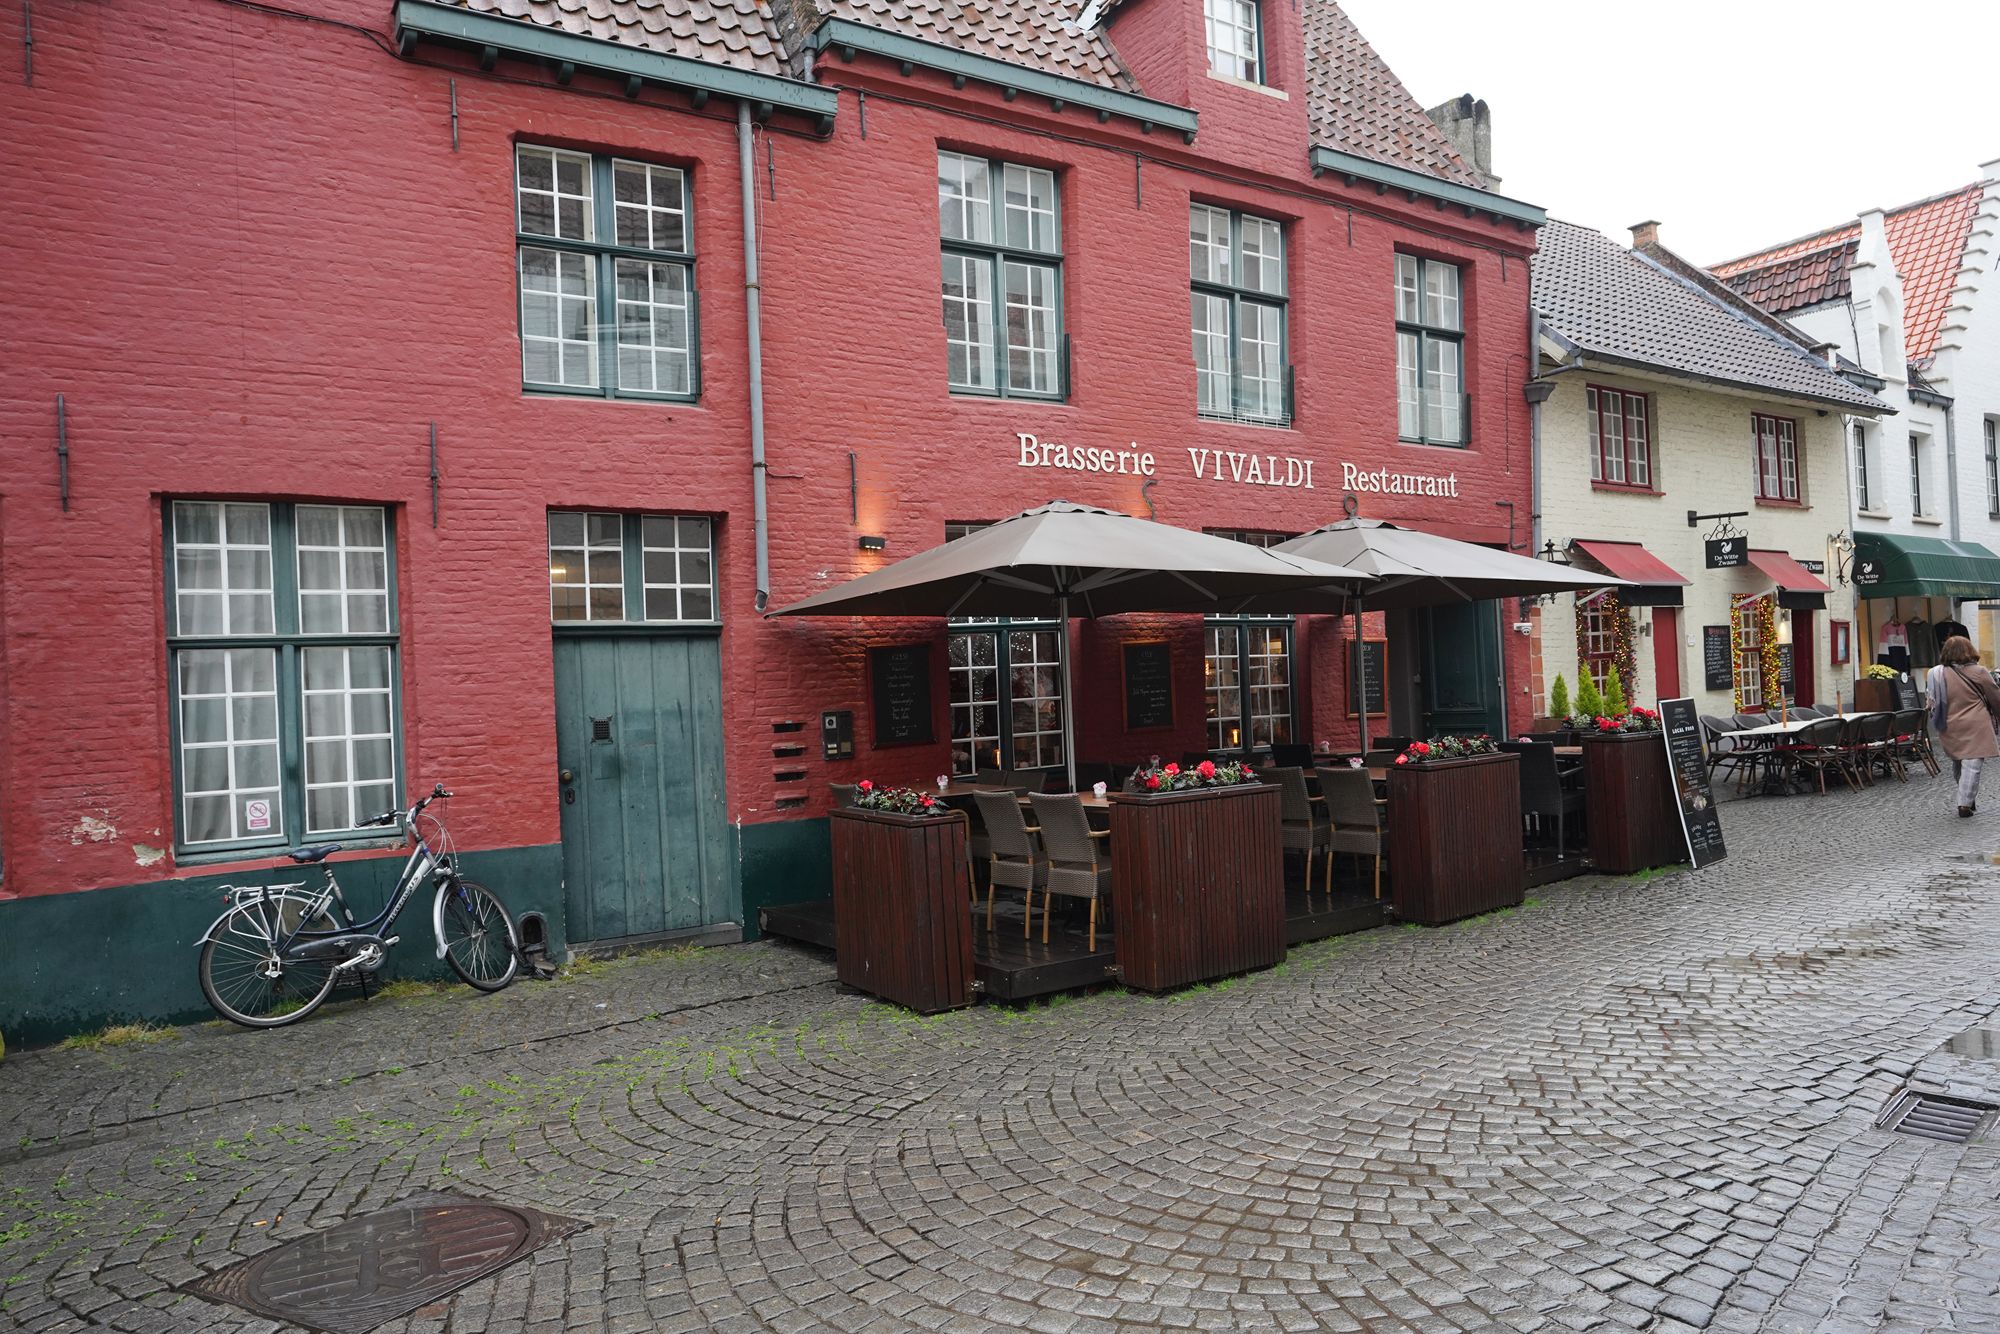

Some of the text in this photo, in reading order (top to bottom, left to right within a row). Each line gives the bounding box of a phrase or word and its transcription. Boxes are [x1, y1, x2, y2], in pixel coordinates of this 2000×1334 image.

[1016, 432, 1459, 498] Brasserie VIVALDI Restaurant
